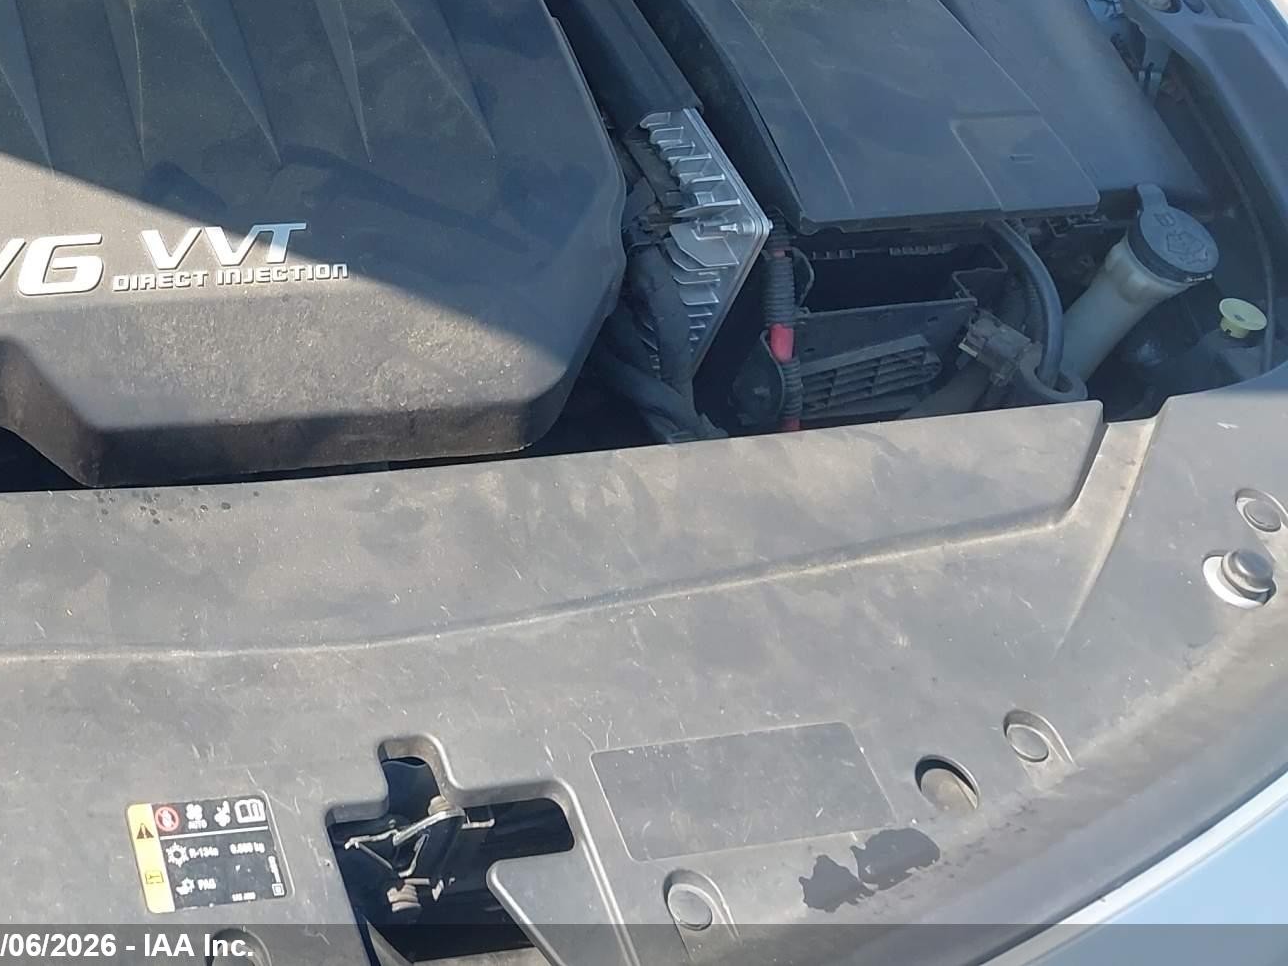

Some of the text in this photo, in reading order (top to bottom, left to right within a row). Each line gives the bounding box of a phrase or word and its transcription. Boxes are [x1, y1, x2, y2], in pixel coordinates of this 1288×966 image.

[142, 222, 307, 271] VVT
[112, 262, 348, 292] DIRECT INJECTION
